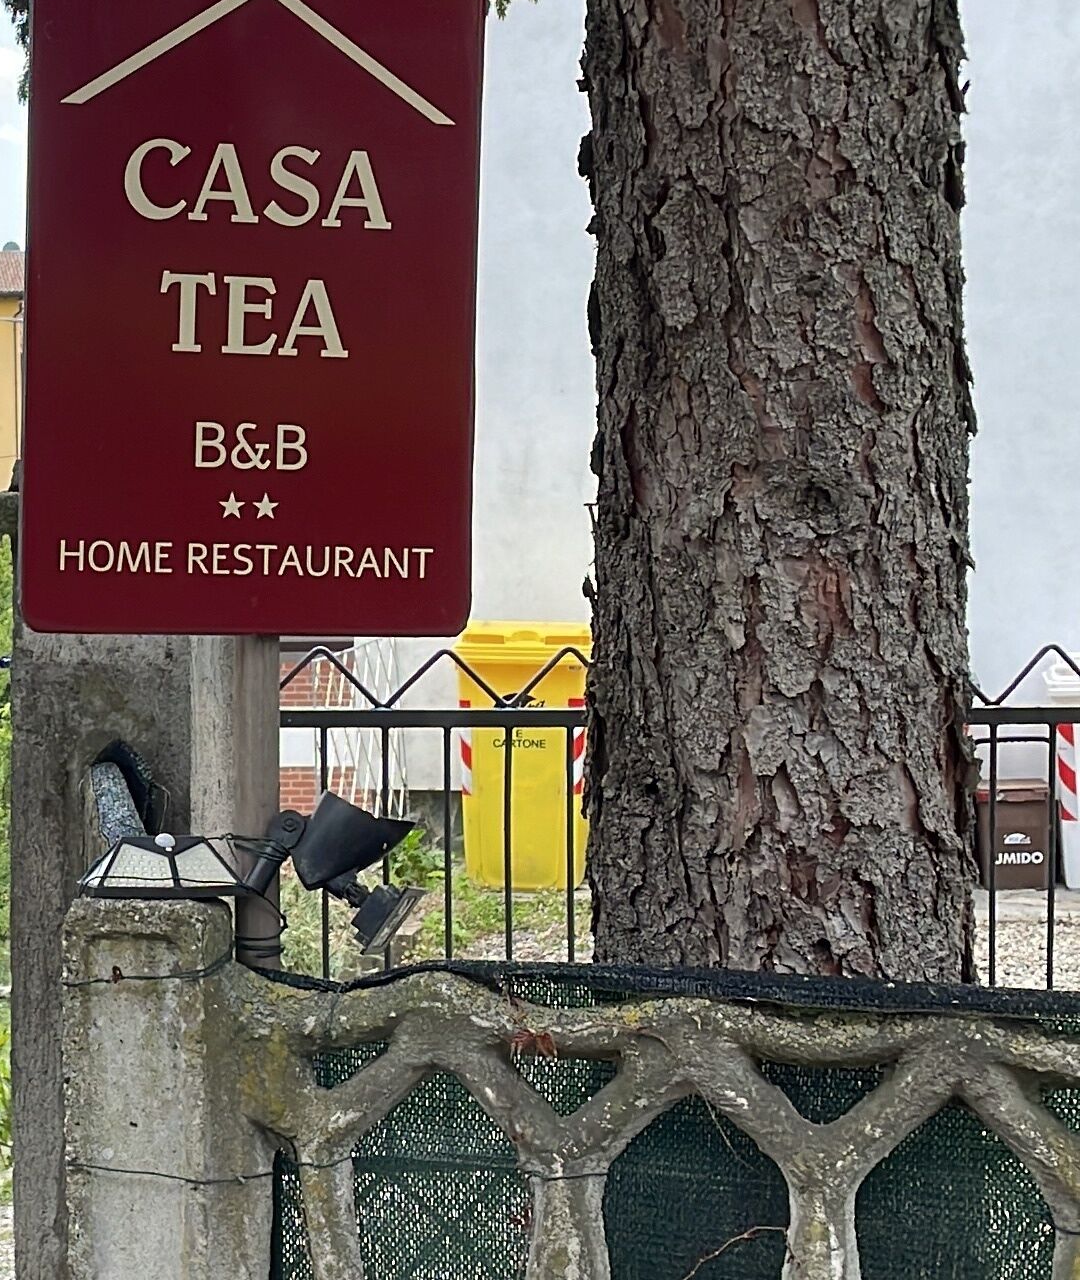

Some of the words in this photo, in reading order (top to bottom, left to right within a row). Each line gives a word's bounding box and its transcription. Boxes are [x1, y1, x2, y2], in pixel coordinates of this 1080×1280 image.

[124, 138, 392, 230] CASA
[160, 270, 349, 358] TEA
[194, 421, 308, 471] B&B
[59, 539, 173, 574] HOME
[187, 542, 434, 579] RESTAURANT
